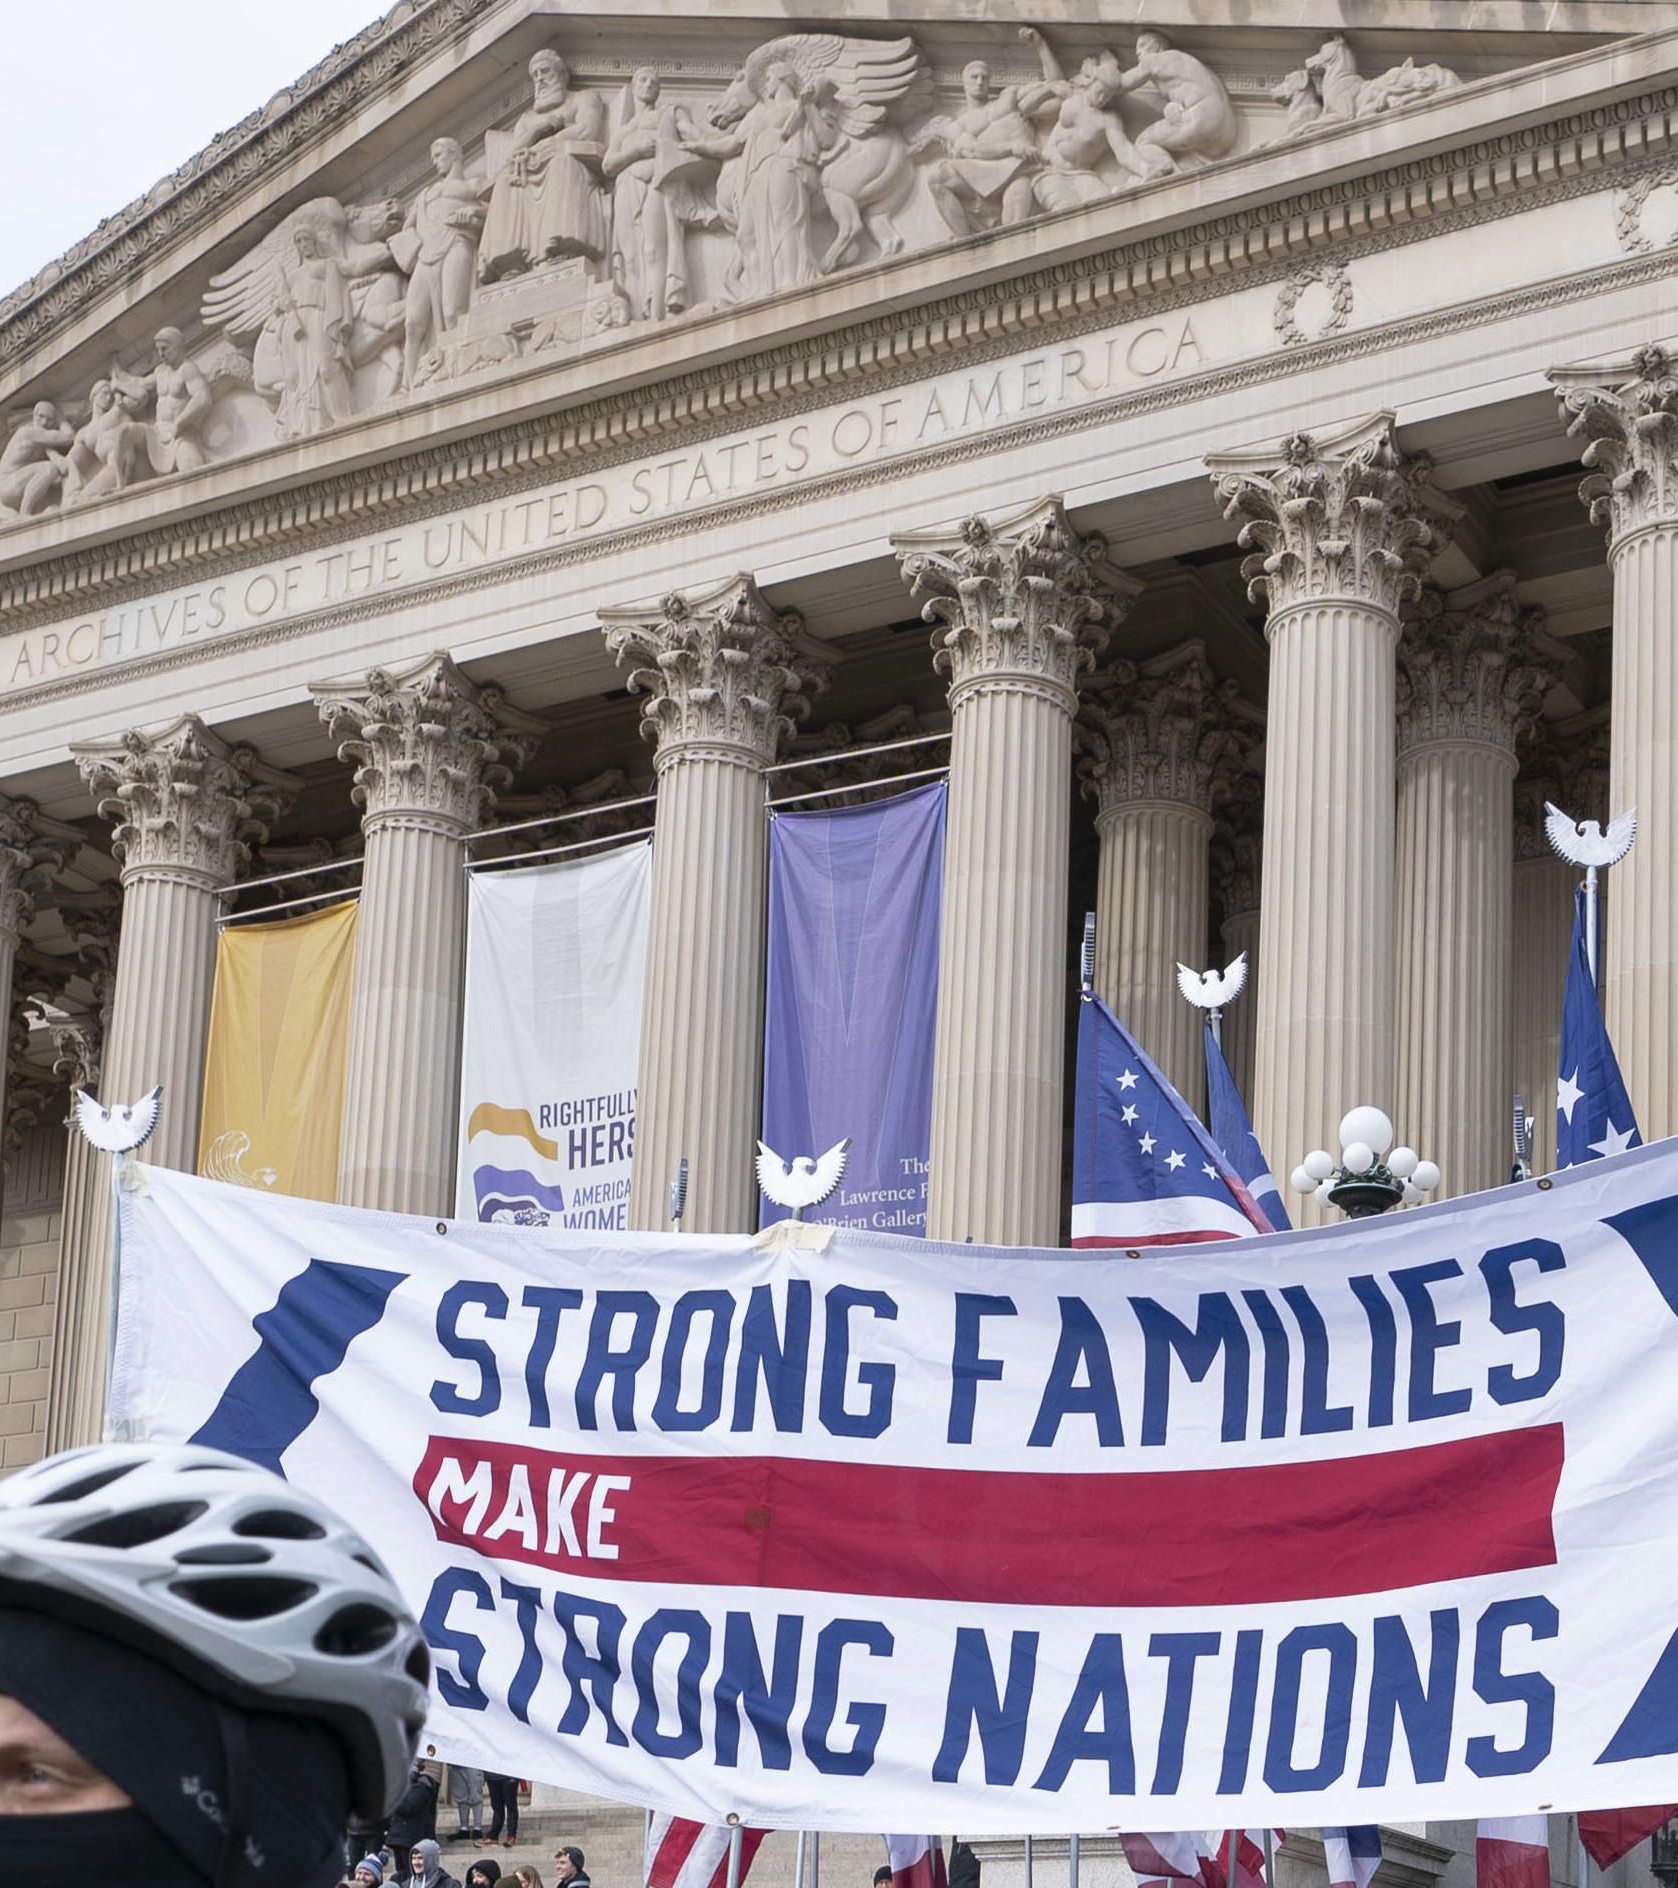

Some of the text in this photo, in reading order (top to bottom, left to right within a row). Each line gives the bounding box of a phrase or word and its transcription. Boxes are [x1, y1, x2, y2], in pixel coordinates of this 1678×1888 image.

[11, 316, 1211, 683] ARCHIVES OF THE UNITED STATES OF AMERICA
[840, 1188, 916, 1206] Lawrence
[429, 1237, 1567, 1448] STRONG FAMILIES
[427, 1456, 632, 1560] MAKE
[420, 1566, 1560, 1796] STRONG NATIONS
